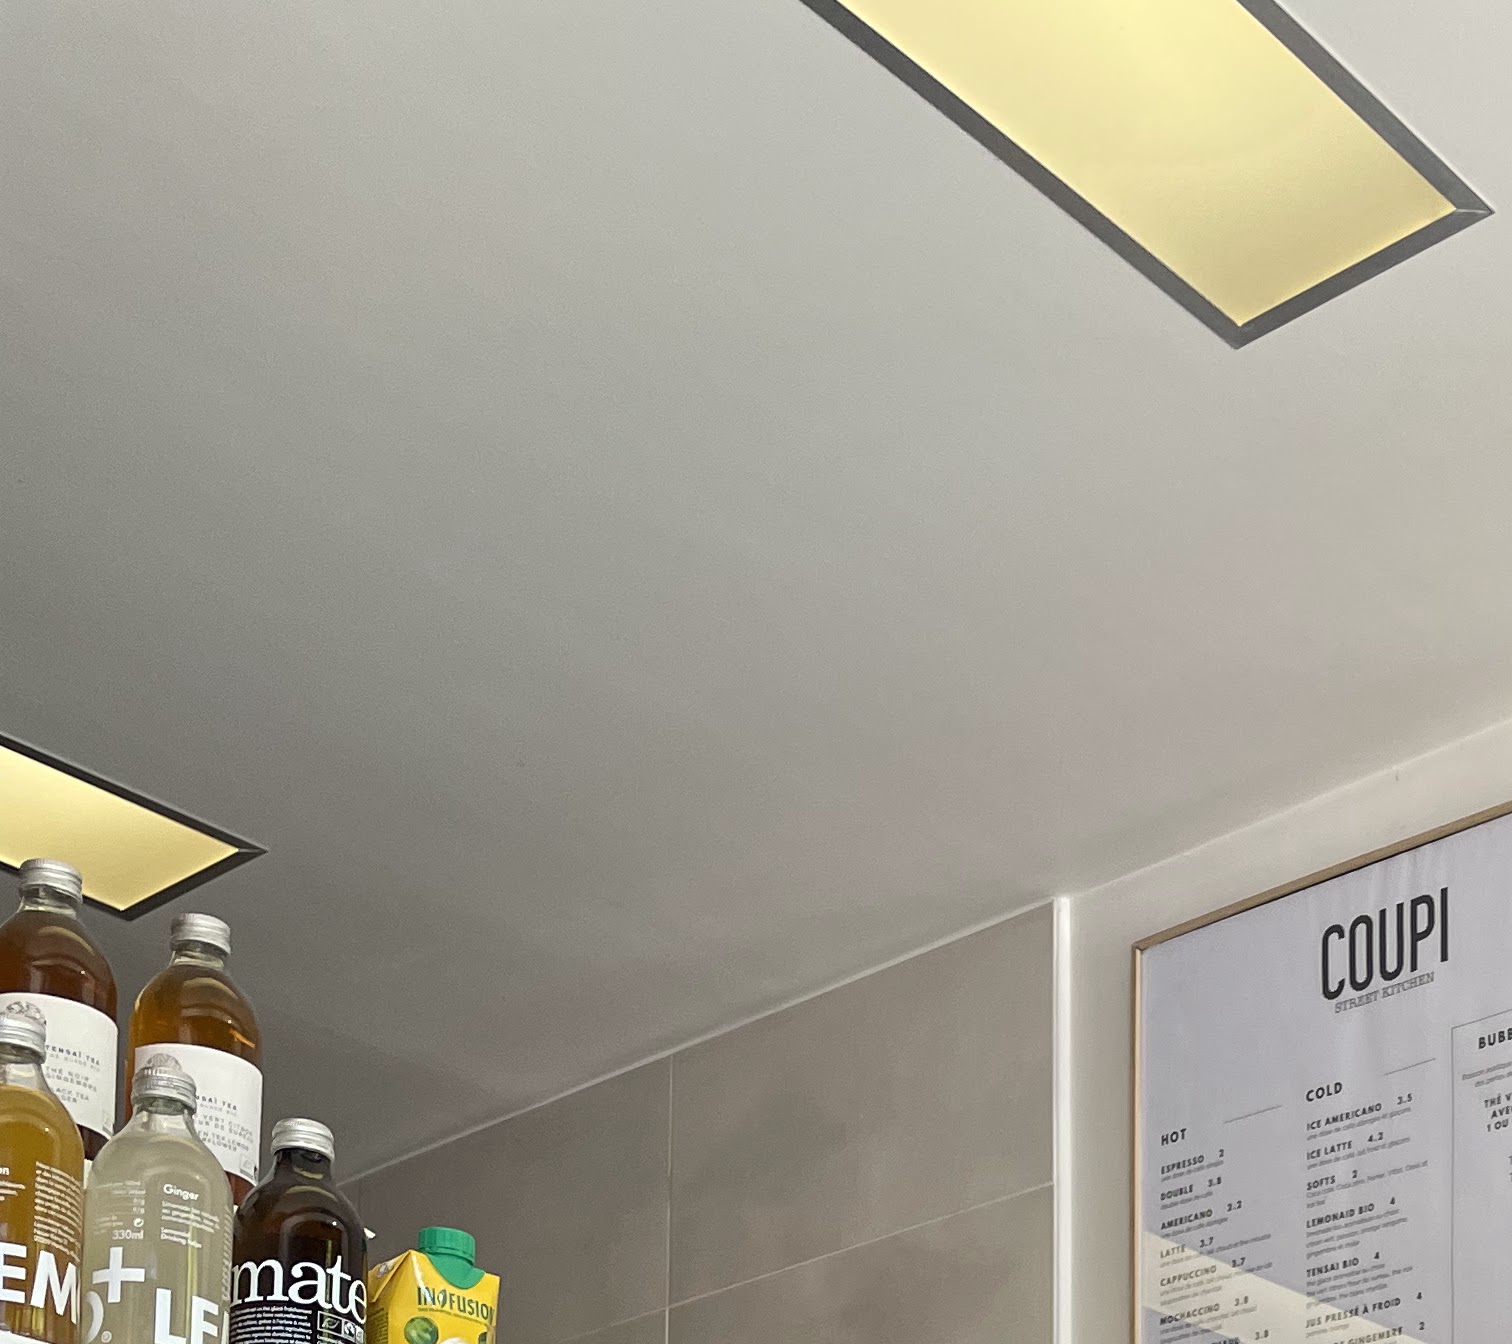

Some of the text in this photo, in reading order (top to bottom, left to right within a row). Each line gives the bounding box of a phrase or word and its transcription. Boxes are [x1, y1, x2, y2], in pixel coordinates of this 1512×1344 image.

[1322, 887, 1448, 1000] COUPI
[1335, 972, 1434, 1013] STREET KITCHEN
[86, 1055, 100, 1065] TEA
[1306, 1082, 1342, 1102] COLD
[1484, 1096, 1501, 1108] THÉ
[1161, 1128, 1187, 1146] HOT
[1161, 1155, 1204, 1175] ESPRESSO
[164, 1183, 199, 1200] Ginger
[232, 1255, 367, 1324] mate
